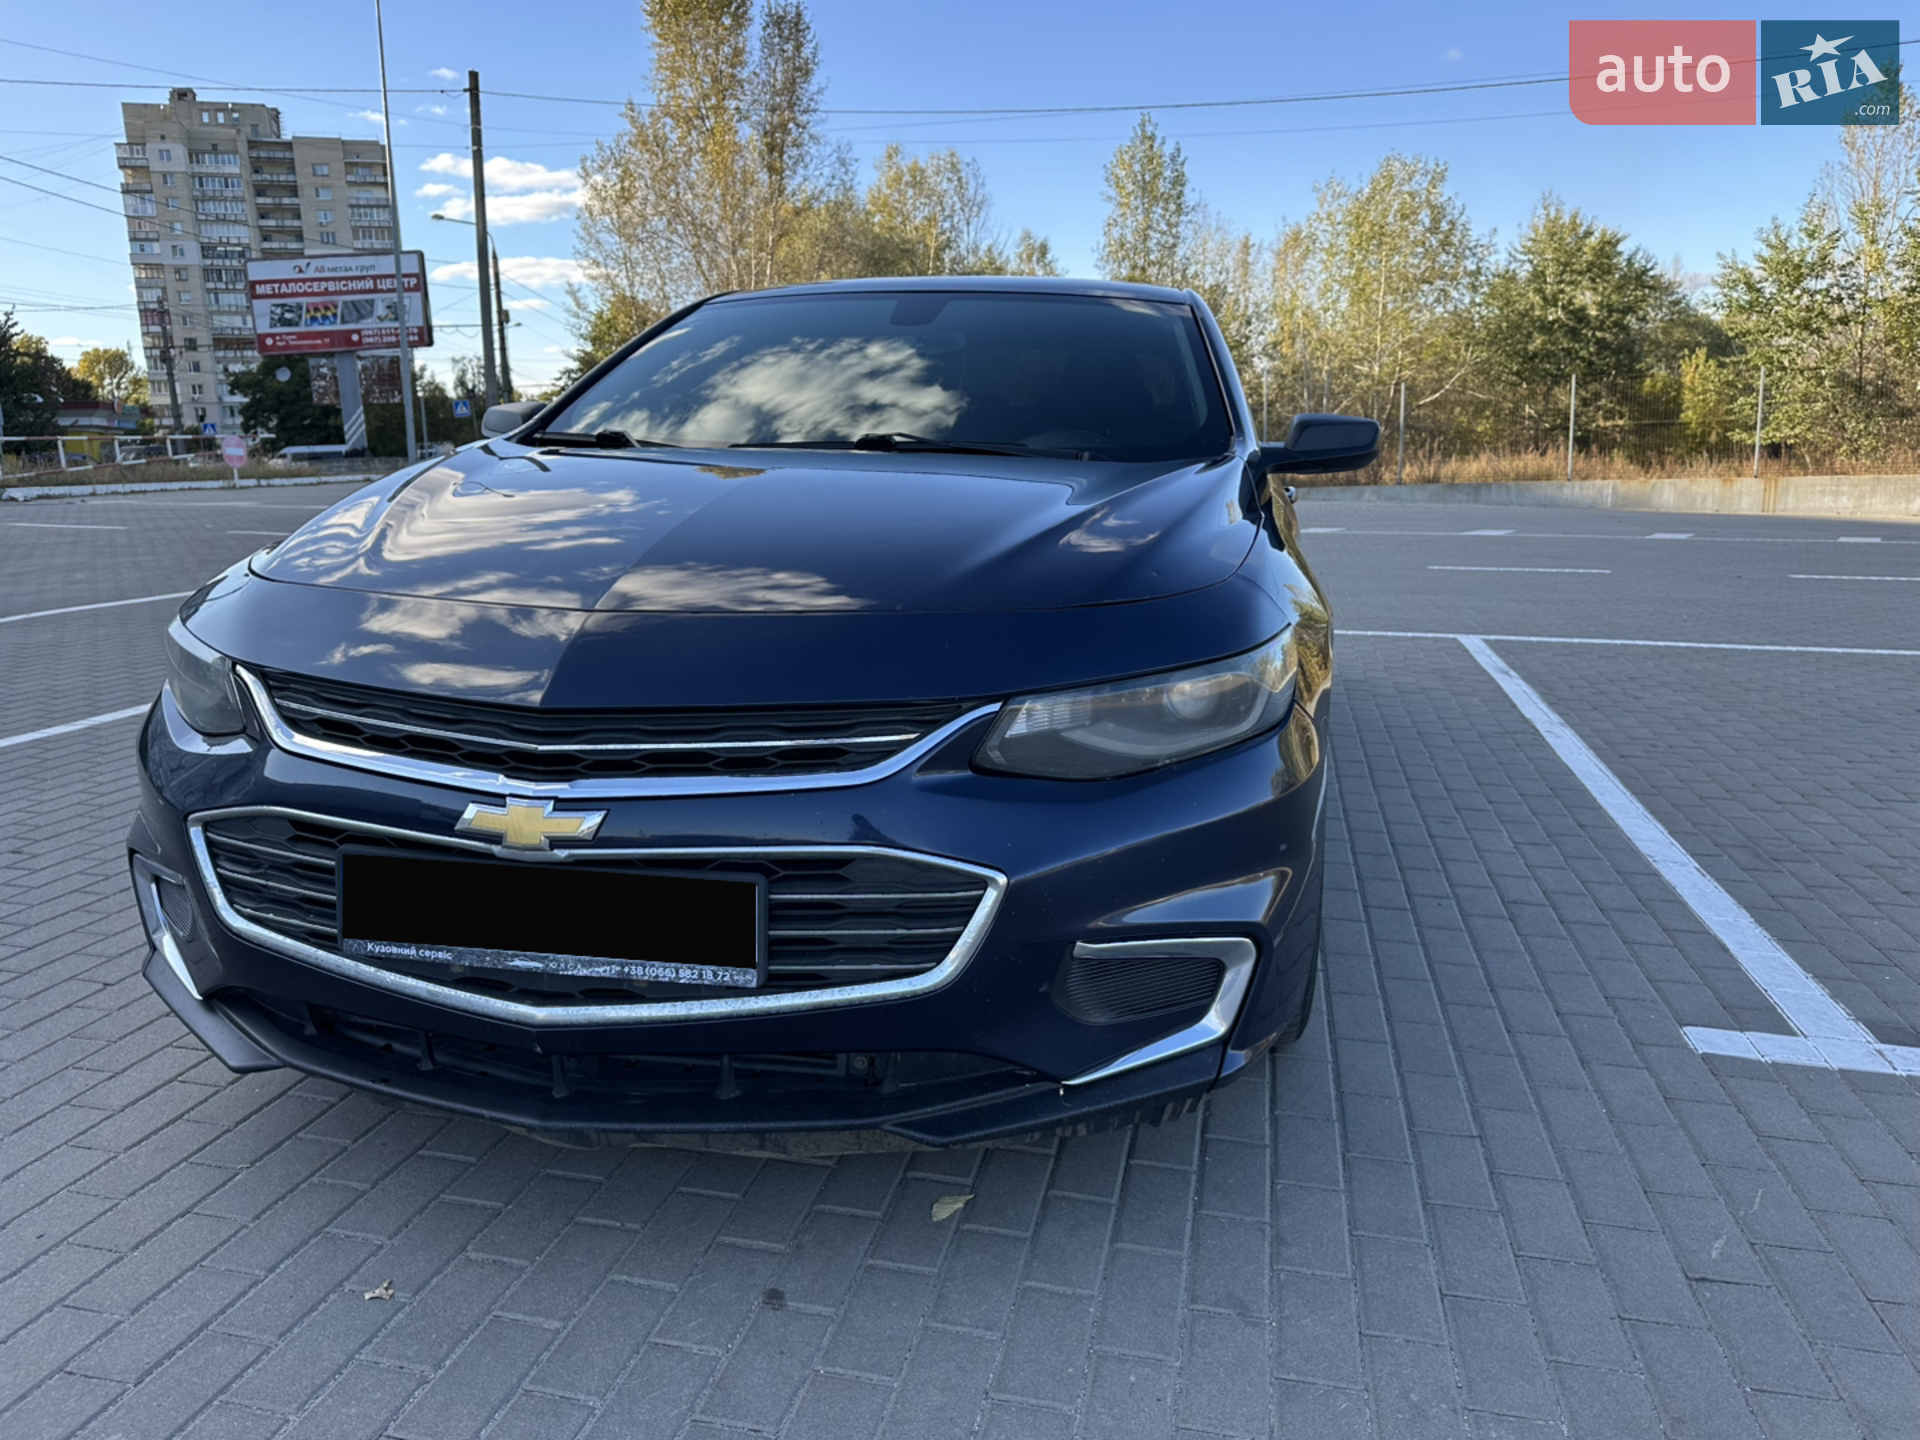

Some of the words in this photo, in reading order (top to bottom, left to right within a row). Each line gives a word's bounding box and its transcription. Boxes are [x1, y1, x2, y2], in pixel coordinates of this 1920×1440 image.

[327, 264, 353, 273] метал
[355, 264, 376, 274] груп
[255, 277, 374, 295] МЕТАЛОСЕРВІСНИЙ
[367, 942, 417, 956] Кузовний
[418, 948, 453, 960] сервіс
[717, 971, 731, 981] 72
